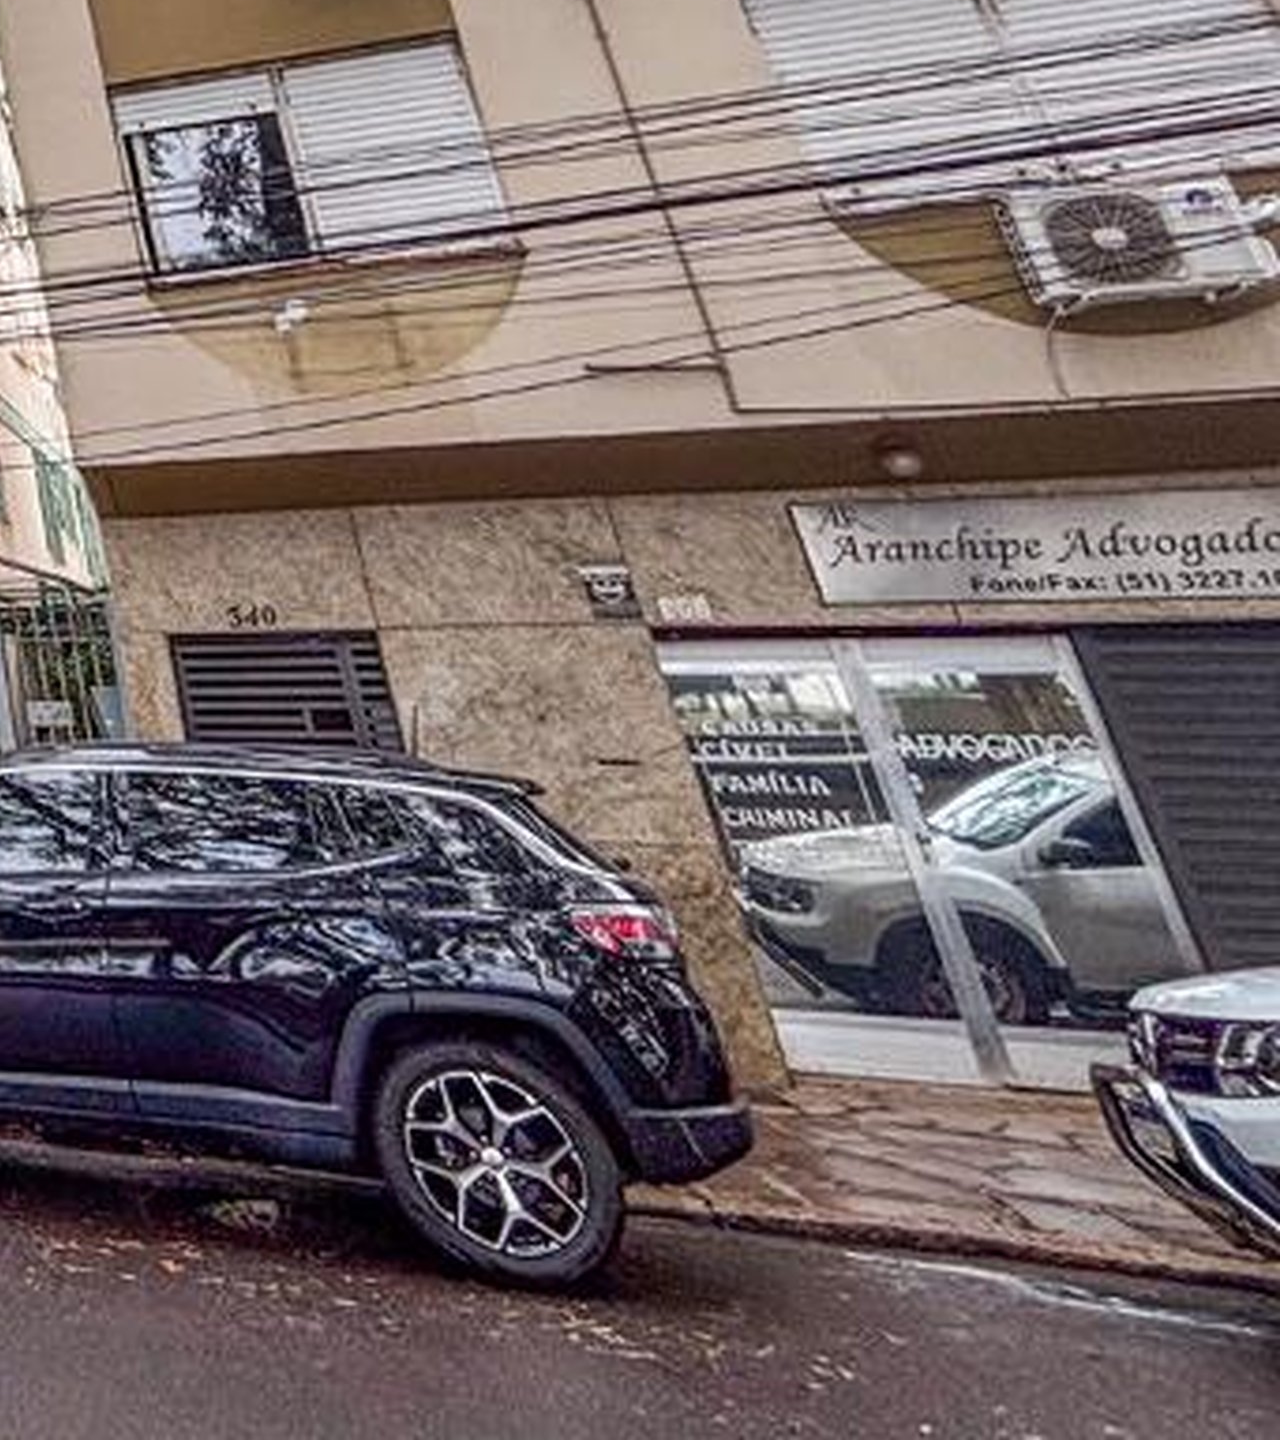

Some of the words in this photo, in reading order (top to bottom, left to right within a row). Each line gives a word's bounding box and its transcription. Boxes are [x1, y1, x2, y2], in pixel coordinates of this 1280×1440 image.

[830, 525, 1044, 570] Aranchipe
[225, 603, 277, 629] 340
[712, 769, 832, 797] FAMÍLIA
